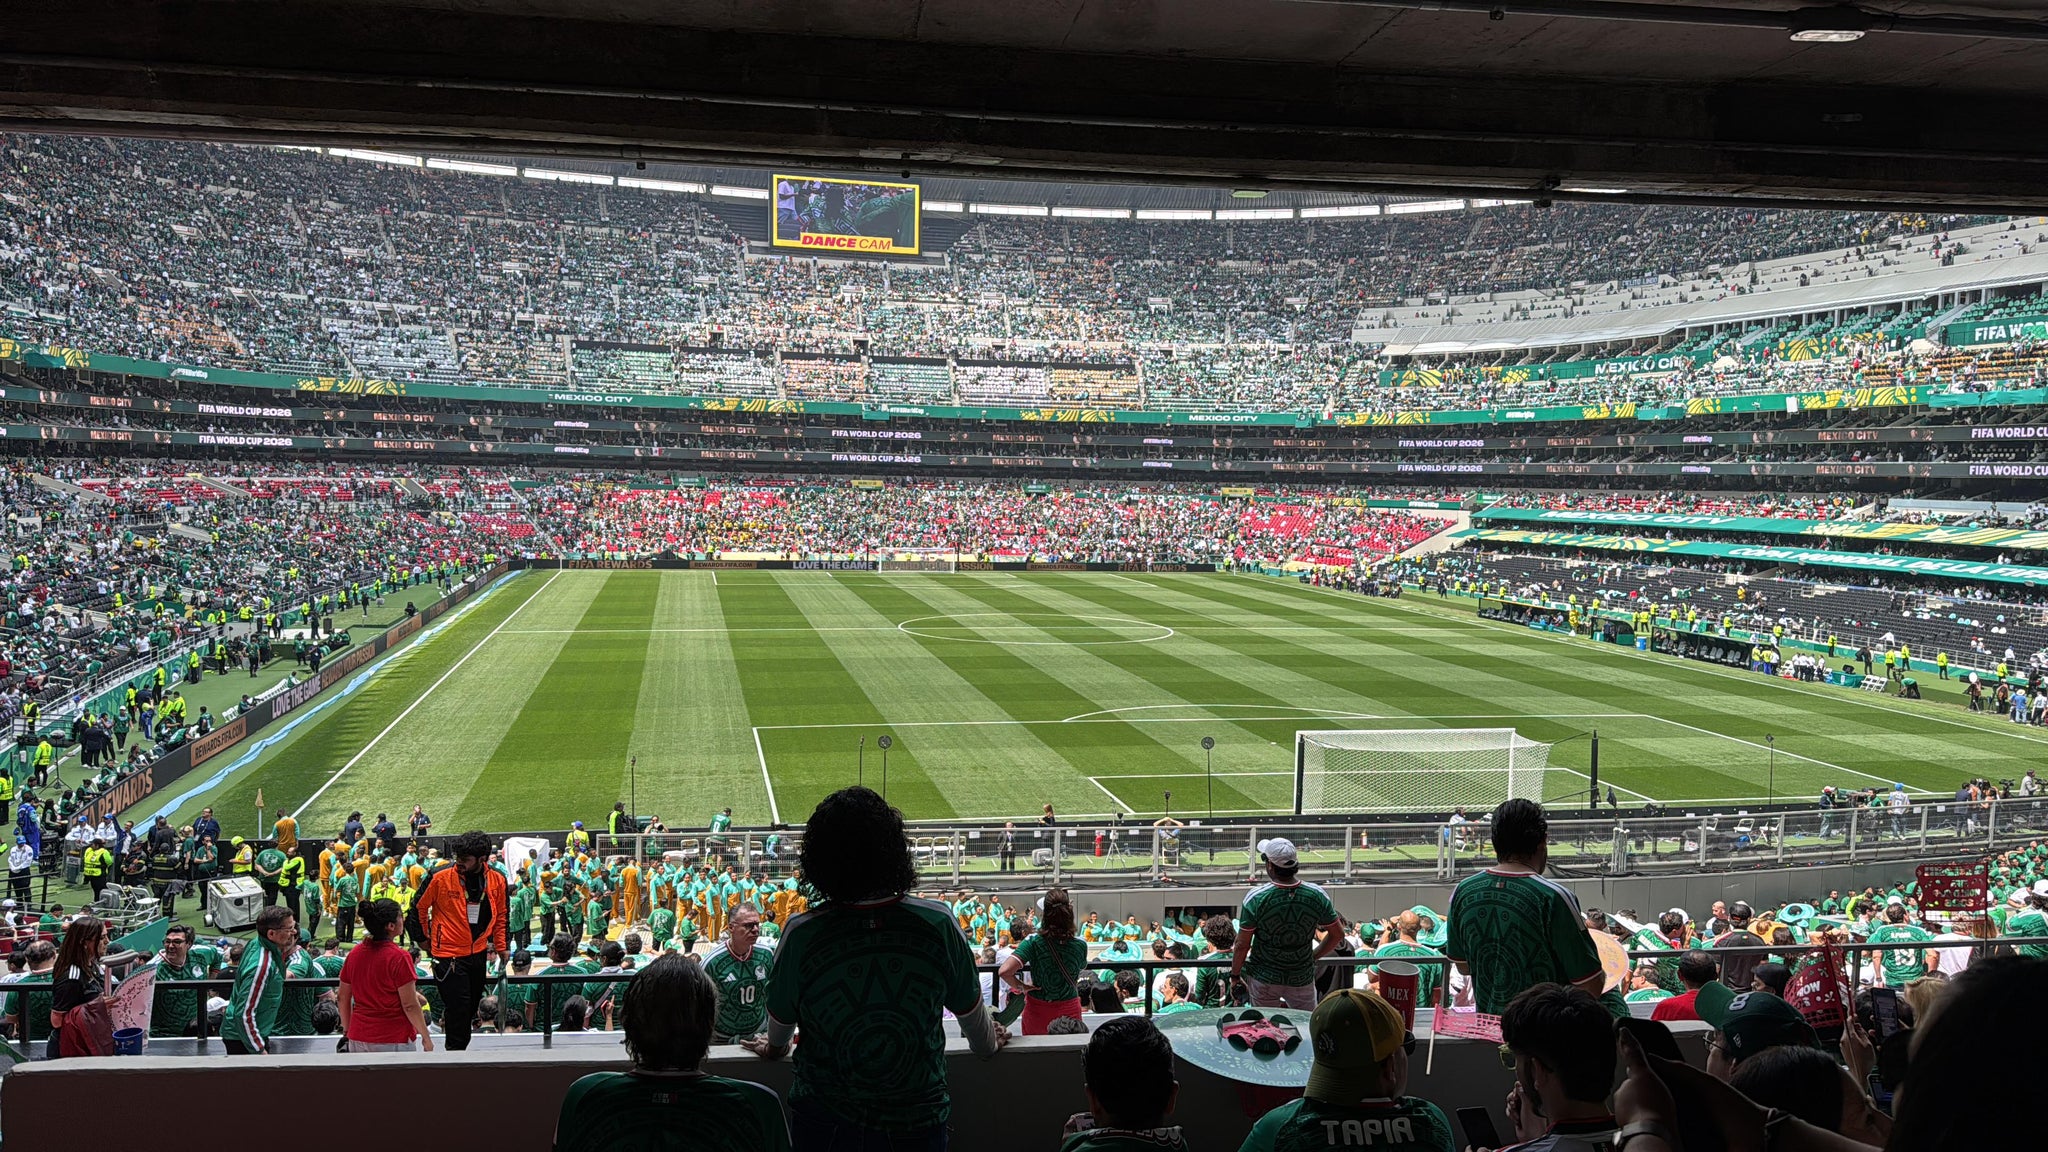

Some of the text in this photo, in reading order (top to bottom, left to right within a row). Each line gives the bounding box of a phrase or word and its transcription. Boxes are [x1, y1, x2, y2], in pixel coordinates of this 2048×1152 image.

[802, 236, 891, 250] DANCE CAM
[1975, 325, 2006, 341] FIFA
[554, 393, 634, 403] MEXICO CITY
[199, 404, 292, 417] FIFA WORLD CUP 2026
[1188, 414, 1258, 422] MEXICO CITY
[832, 430, 922, 440] FIFA WORLD CUP 2026
[1971, 428, 1994, 438] FIFA
[1995, 427, 2035, 438] WORLD
[199, 435, 292, 446] FIFA WORLD CUP 2026
[1398, 440, 1484, 448] FIFA WORLD CUP 2026
[832, 454, 922, 463] FIFA WORLD CUP 2026
[1398, 464, 1483, 472] FIFA WORLD CUP 2026
[1969, 465, 1992, 476] FIFA
[1993, 465, 2032, 476] WORLD
[1539, 511, 1737, 525] MEXICO CITY
[570, 560, 653, 568] FIFA REWARDS
[793, 562, 818, 570] LOVE
[820, 562, 842, 570] THE
[844, 562, 874, 570] GAME
[1729, 548, 1795, 560] COPA
[1794, 552, 1907, 568] MUNDIAL
[1907, 560, 1945, 572] DE
[1945, 563, 1992, 575] LA
[1119, 564, 1188, 572] FIFA RWARDS
[272, 690, 292, 718] LOVE
[290, 685, 304, 710] THE
[303, 674, 320, 702] GAME
[195, 724, 244, 757] REWARDS.FIFA.COM
[98, 768, 153, 822] REWARDS
[740, 985, 756, 1004] 10
[1388, 986, 1410, 1000] MEX
[1320, 1116, 1416, 1146] TAPIA
